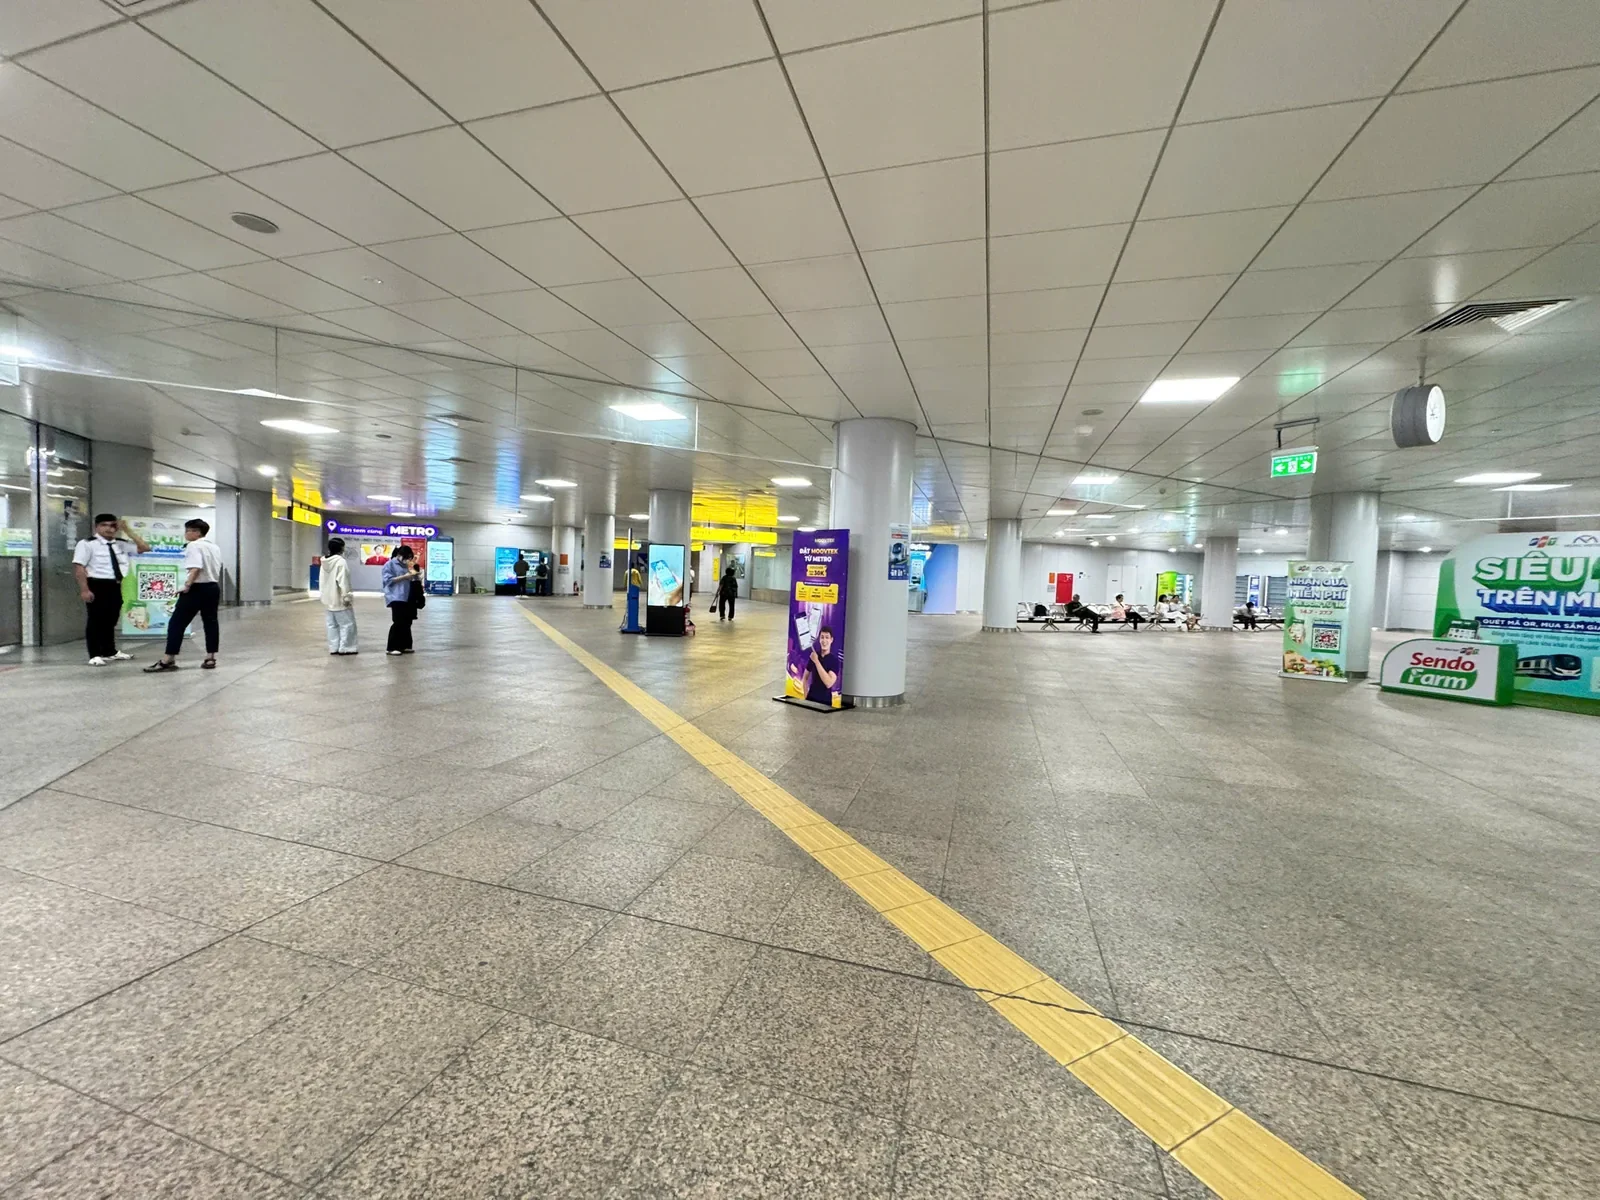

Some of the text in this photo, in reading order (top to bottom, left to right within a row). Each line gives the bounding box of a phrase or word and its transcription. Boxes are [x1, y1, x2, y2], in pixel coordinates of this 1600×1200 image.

[390, 525, 435, 536] METRO
[1474, 550, 1589, 584] SIÊU
[1323, 589, 1348, 601] PHÍ
[1477, 586, 1558, 609] TRÊN
[1409, 652, 1475, 671] Sendo
[1408, 669, 1467, 690] Farm
